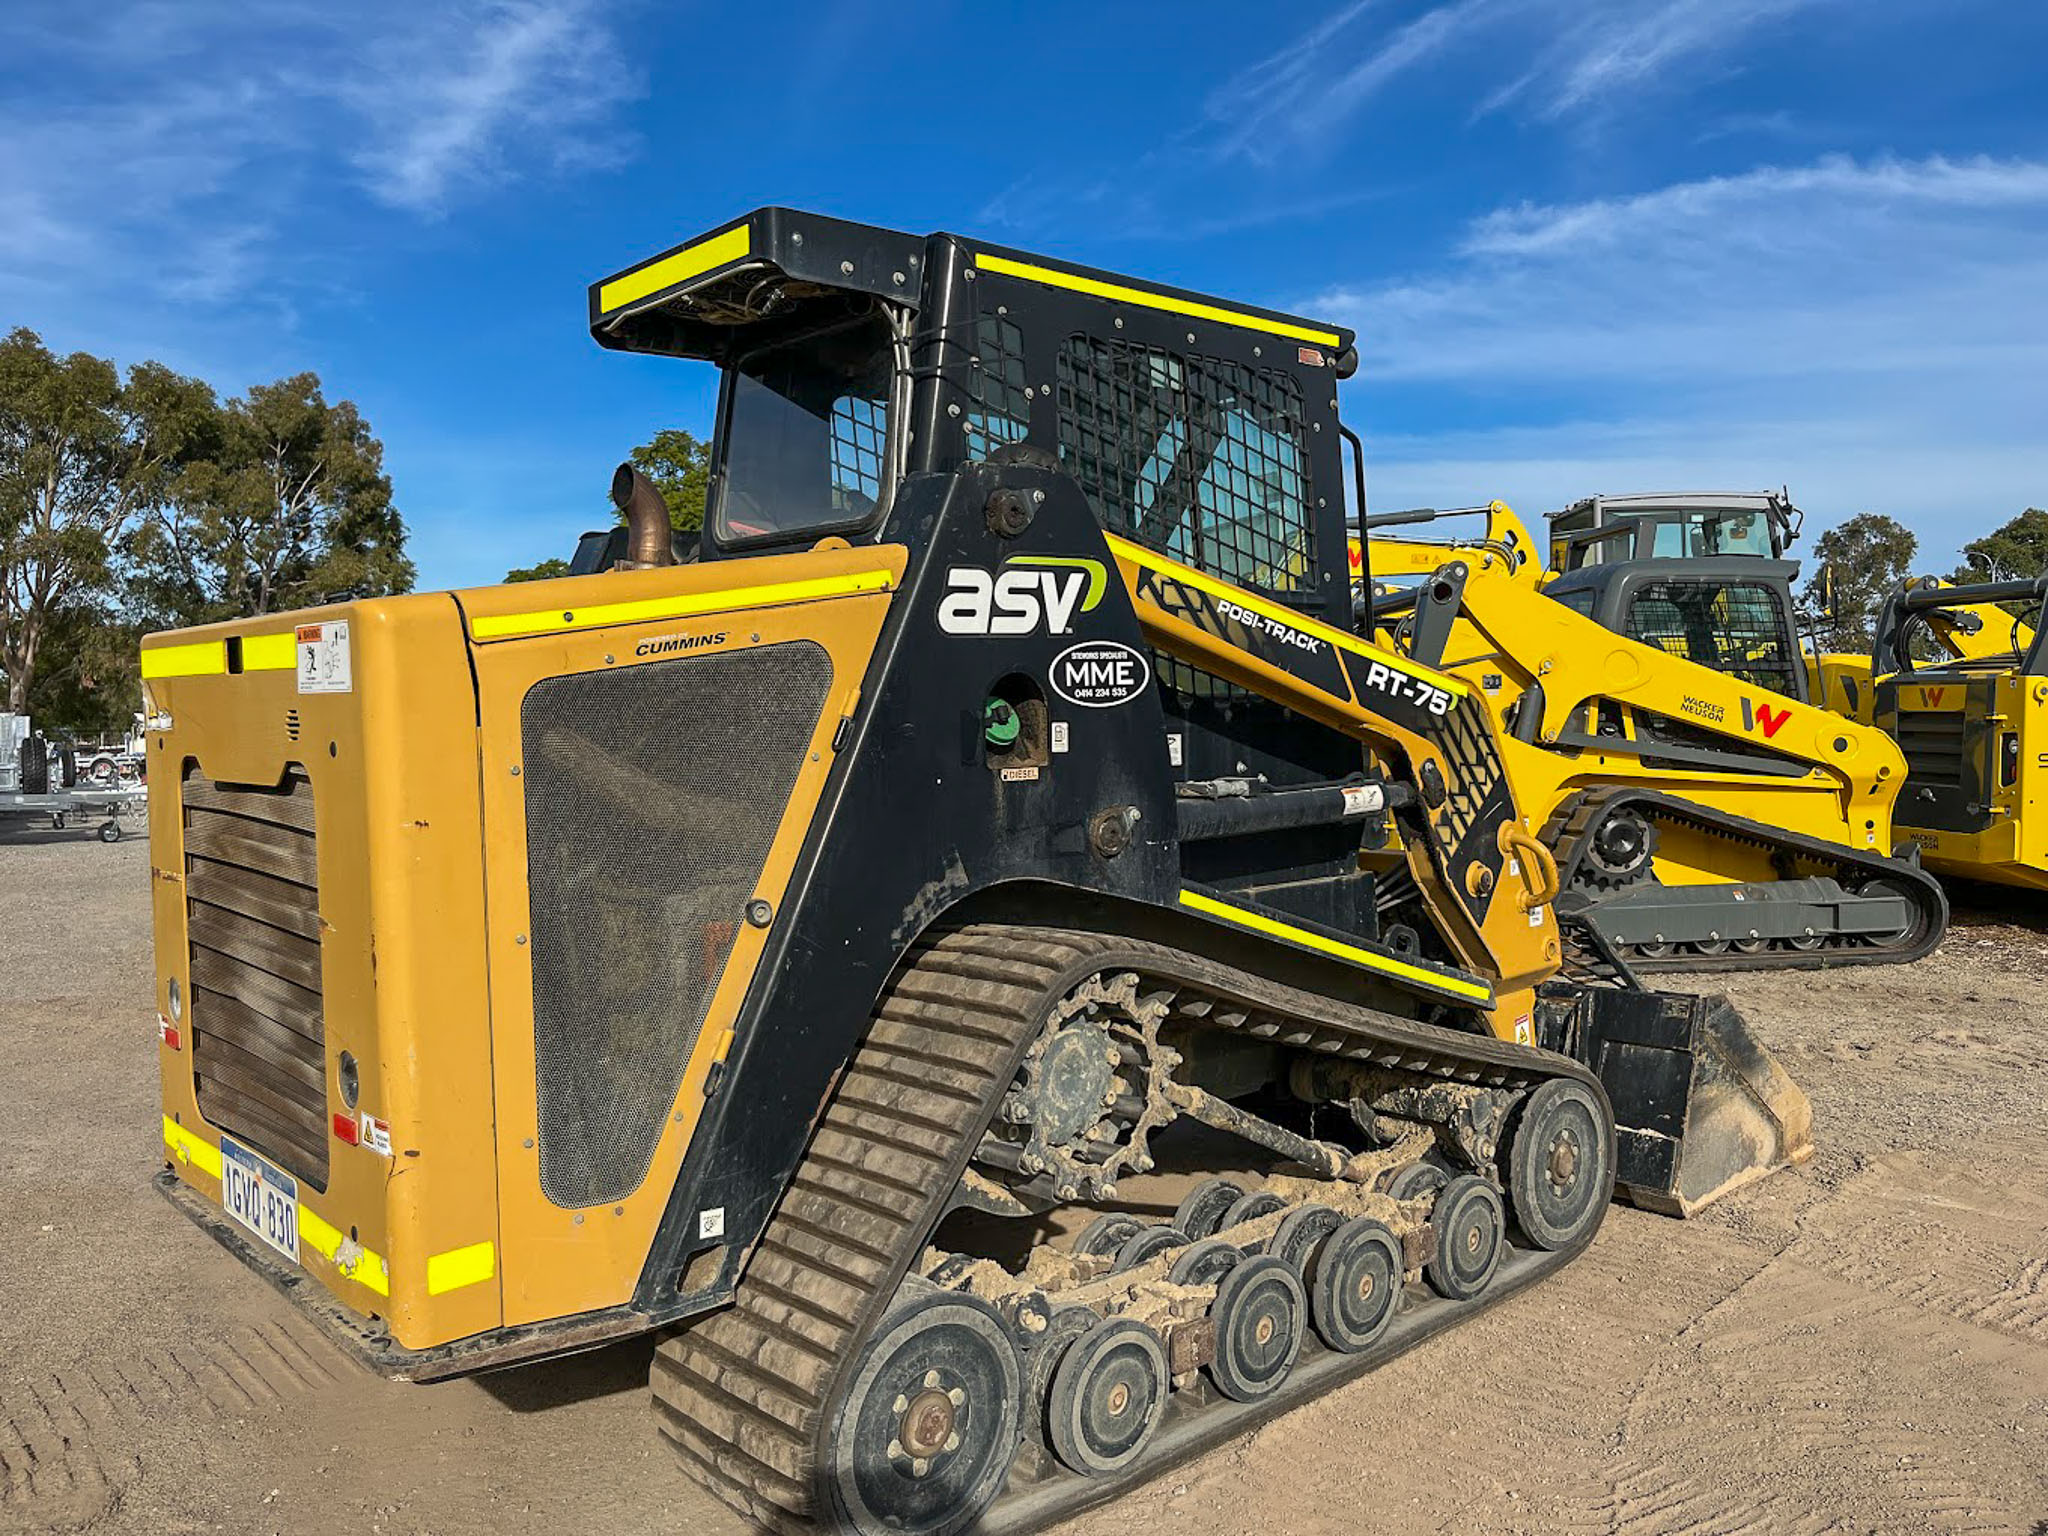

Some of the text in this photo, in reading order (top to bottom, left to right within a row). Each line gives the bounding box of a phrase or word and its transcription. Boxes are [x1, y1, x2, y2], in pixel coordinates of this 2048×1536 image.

[1217, 600, 1320, 654] POSI-TRACK
[636, 633, 726, 656] CUMMINS
[1065, 661, 1134, 687] MME
[1074, 687, 1127, 698] 0414 234 535
[1365, 662, 1450, 716] RT-75
[1680, 703, 1724, 723] NEUSON
[1682, 694, 1725, 715] WACKER
[1009, 769, 1037, 779] DIESEL
